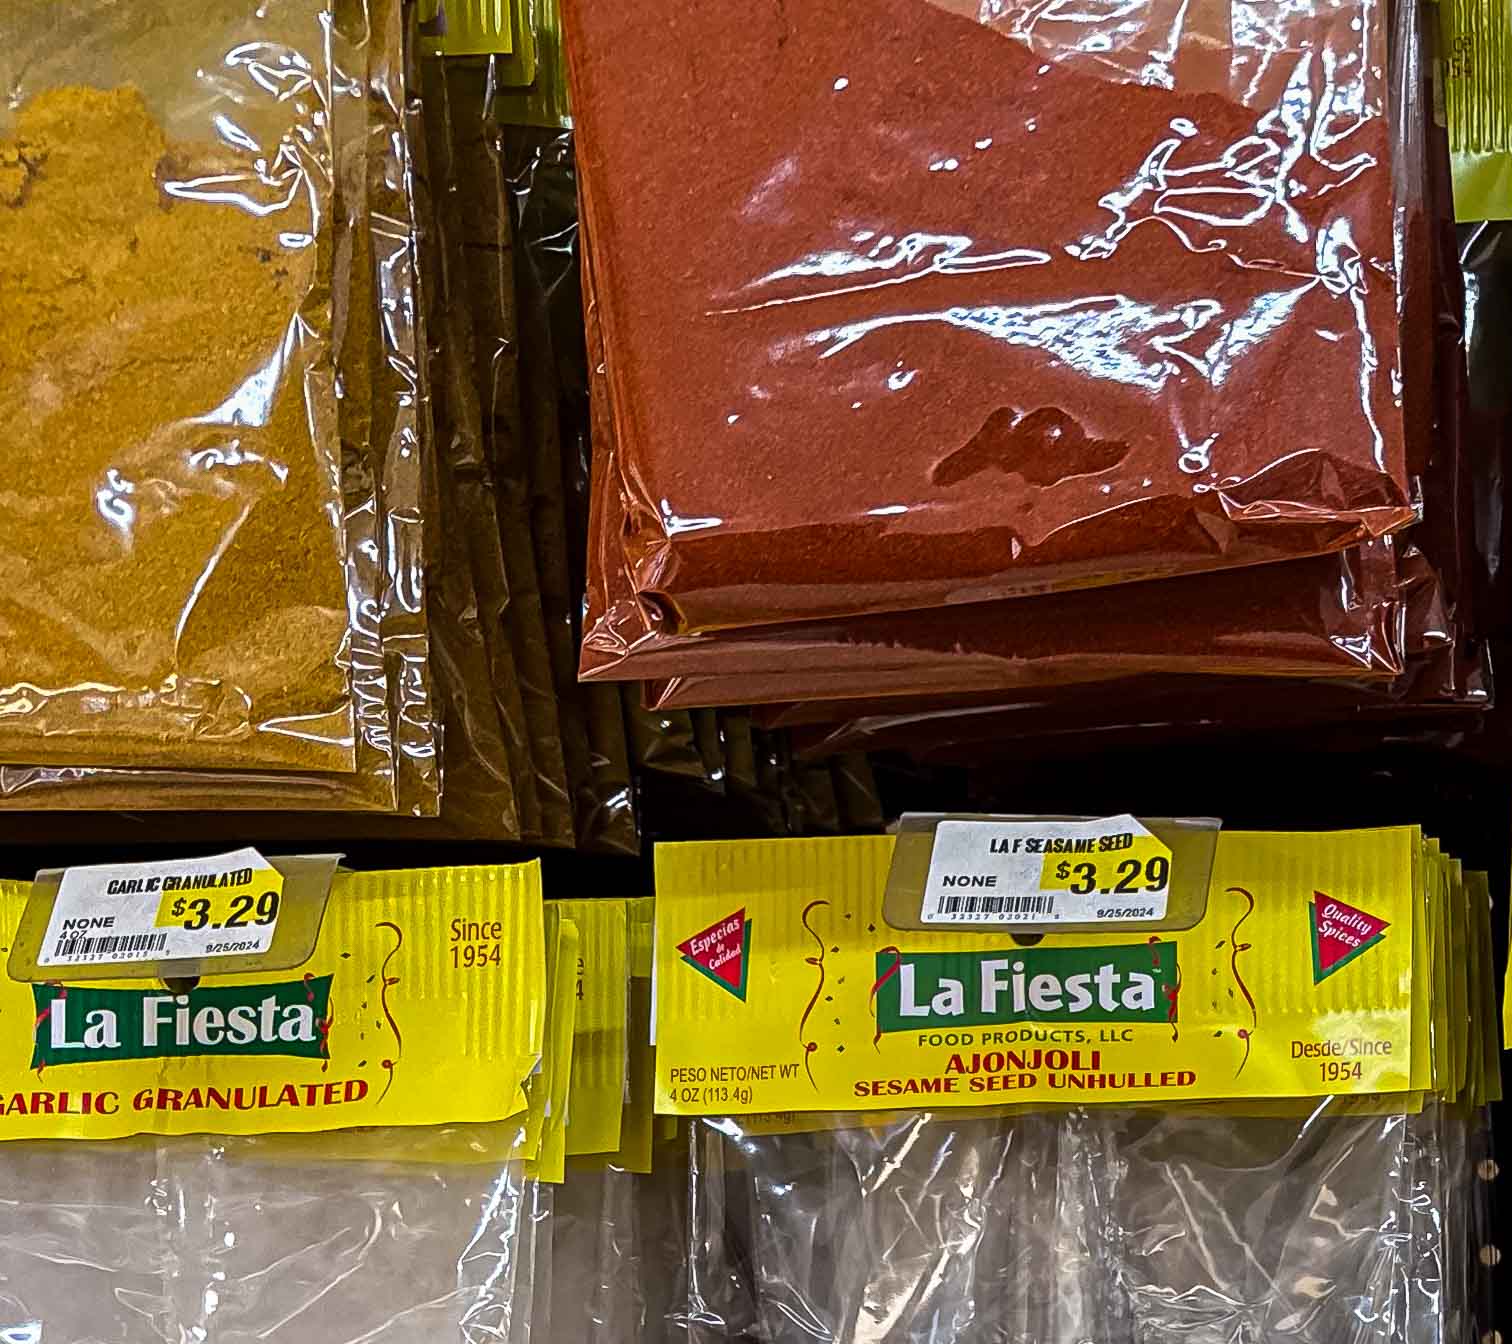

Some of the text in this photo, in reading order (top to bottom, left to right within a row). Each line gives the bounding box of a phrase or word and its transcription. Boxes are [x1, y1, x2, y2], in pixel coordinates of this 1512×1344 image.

[107, 868, 252, 895] GARLIC GRANULATED
[942, 875, 997, 887] NONE
[1055, 856, 1170, 895] $3.29
[63, 917, 116, 930] NONE
[172, 891, 279, 930] $3.29
[1321, 903, 1372, 936] Quality
[450, 918, 502, 942] Since
[689, 918, 740, 956] Especias
[1318, 920, 1361, 948] Spices
[450, 944, 502, 969] 1954
[899, 958, 1156, 1018] La Fiesta
[50, 995, 316, 1049] La Fiesta
[918, 1028, 1134, 1047] FOOD PRODUCTS, LLC
[1291, 1039, 1393, 1059] Desde/Since
[670, 1064, 800, 1083] PESO NETO/NET WT
[944, 1050, 1101, 1075] AJONJOLI
[1319, 1062, 1362, 1082] 1954
[854, 1070, 1197, 1097] SESAME SEED UNHULLED
